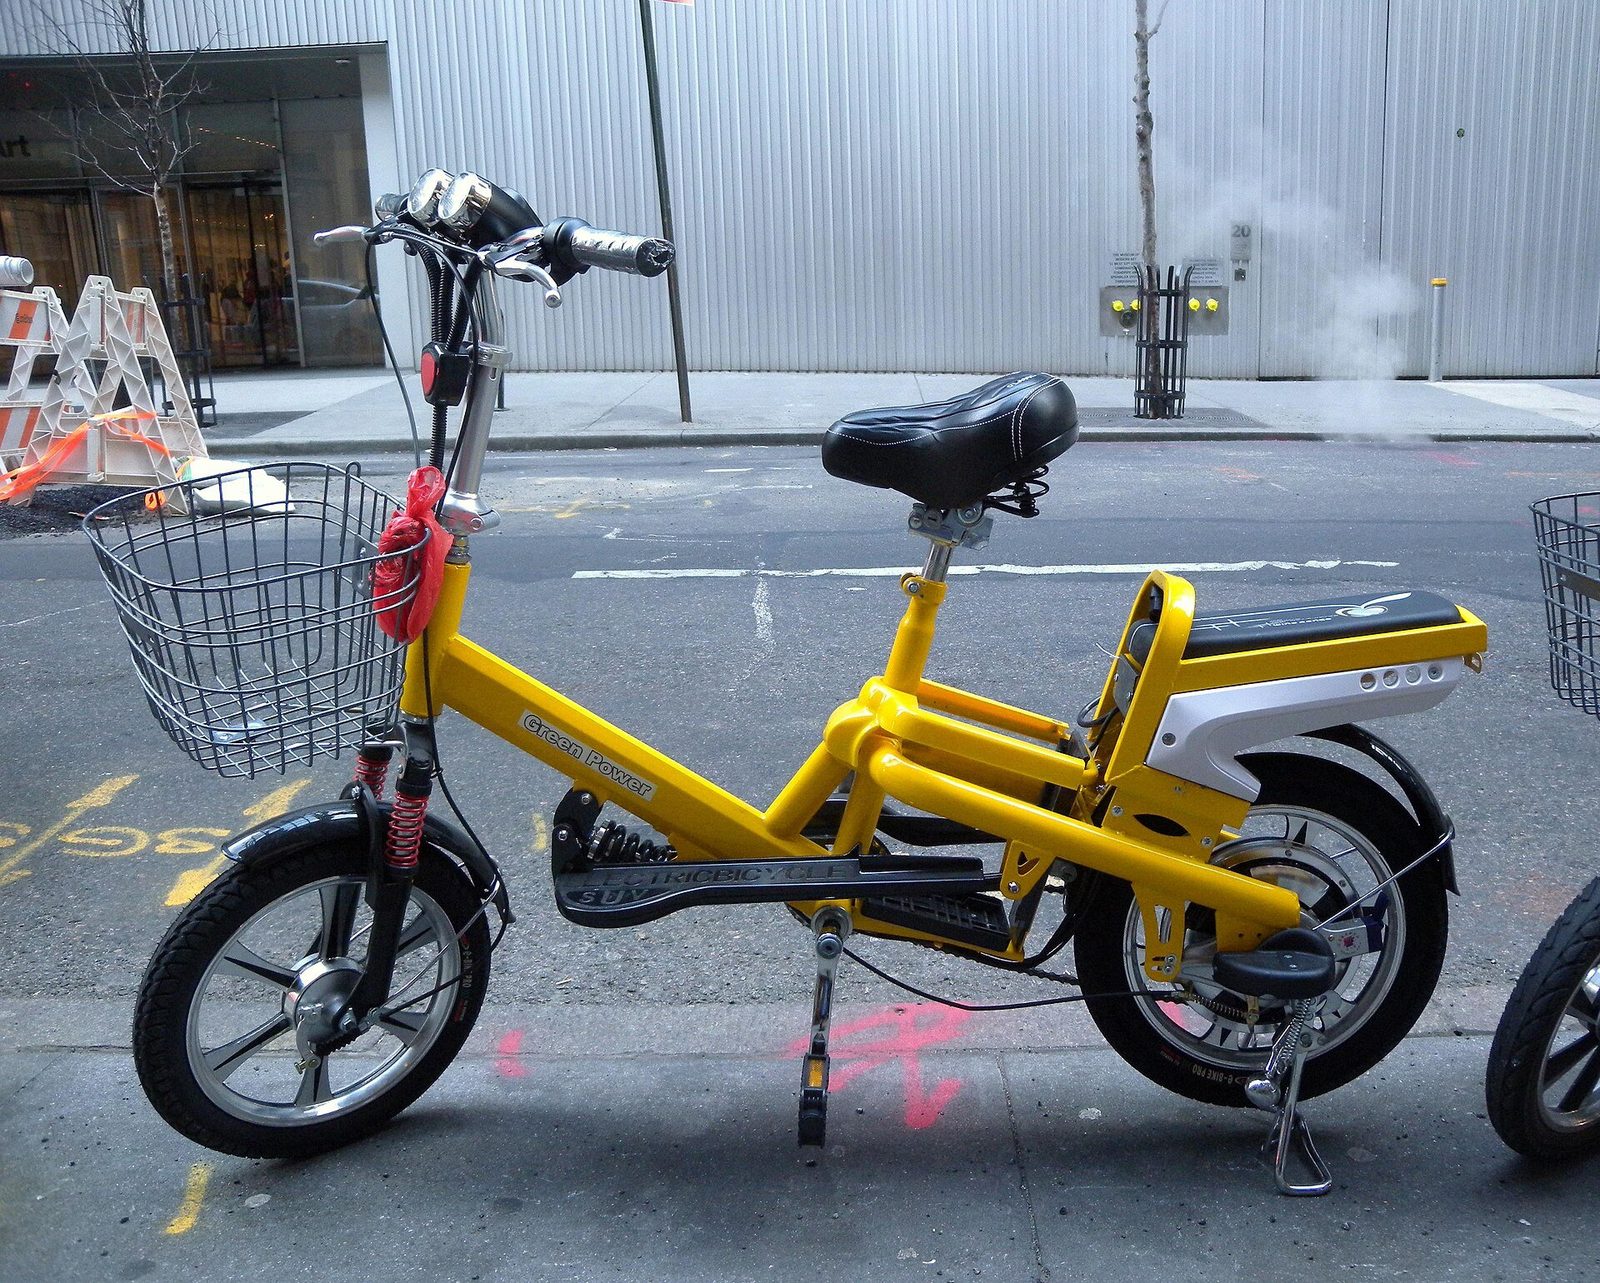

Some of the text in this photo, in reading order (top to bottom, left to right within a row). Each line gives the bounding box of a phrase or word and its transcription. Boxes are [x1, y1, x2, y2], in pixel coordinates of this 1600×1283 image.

[1231, 224, 1251, 238] 20
[524, 714, 651, 796] Green Power
